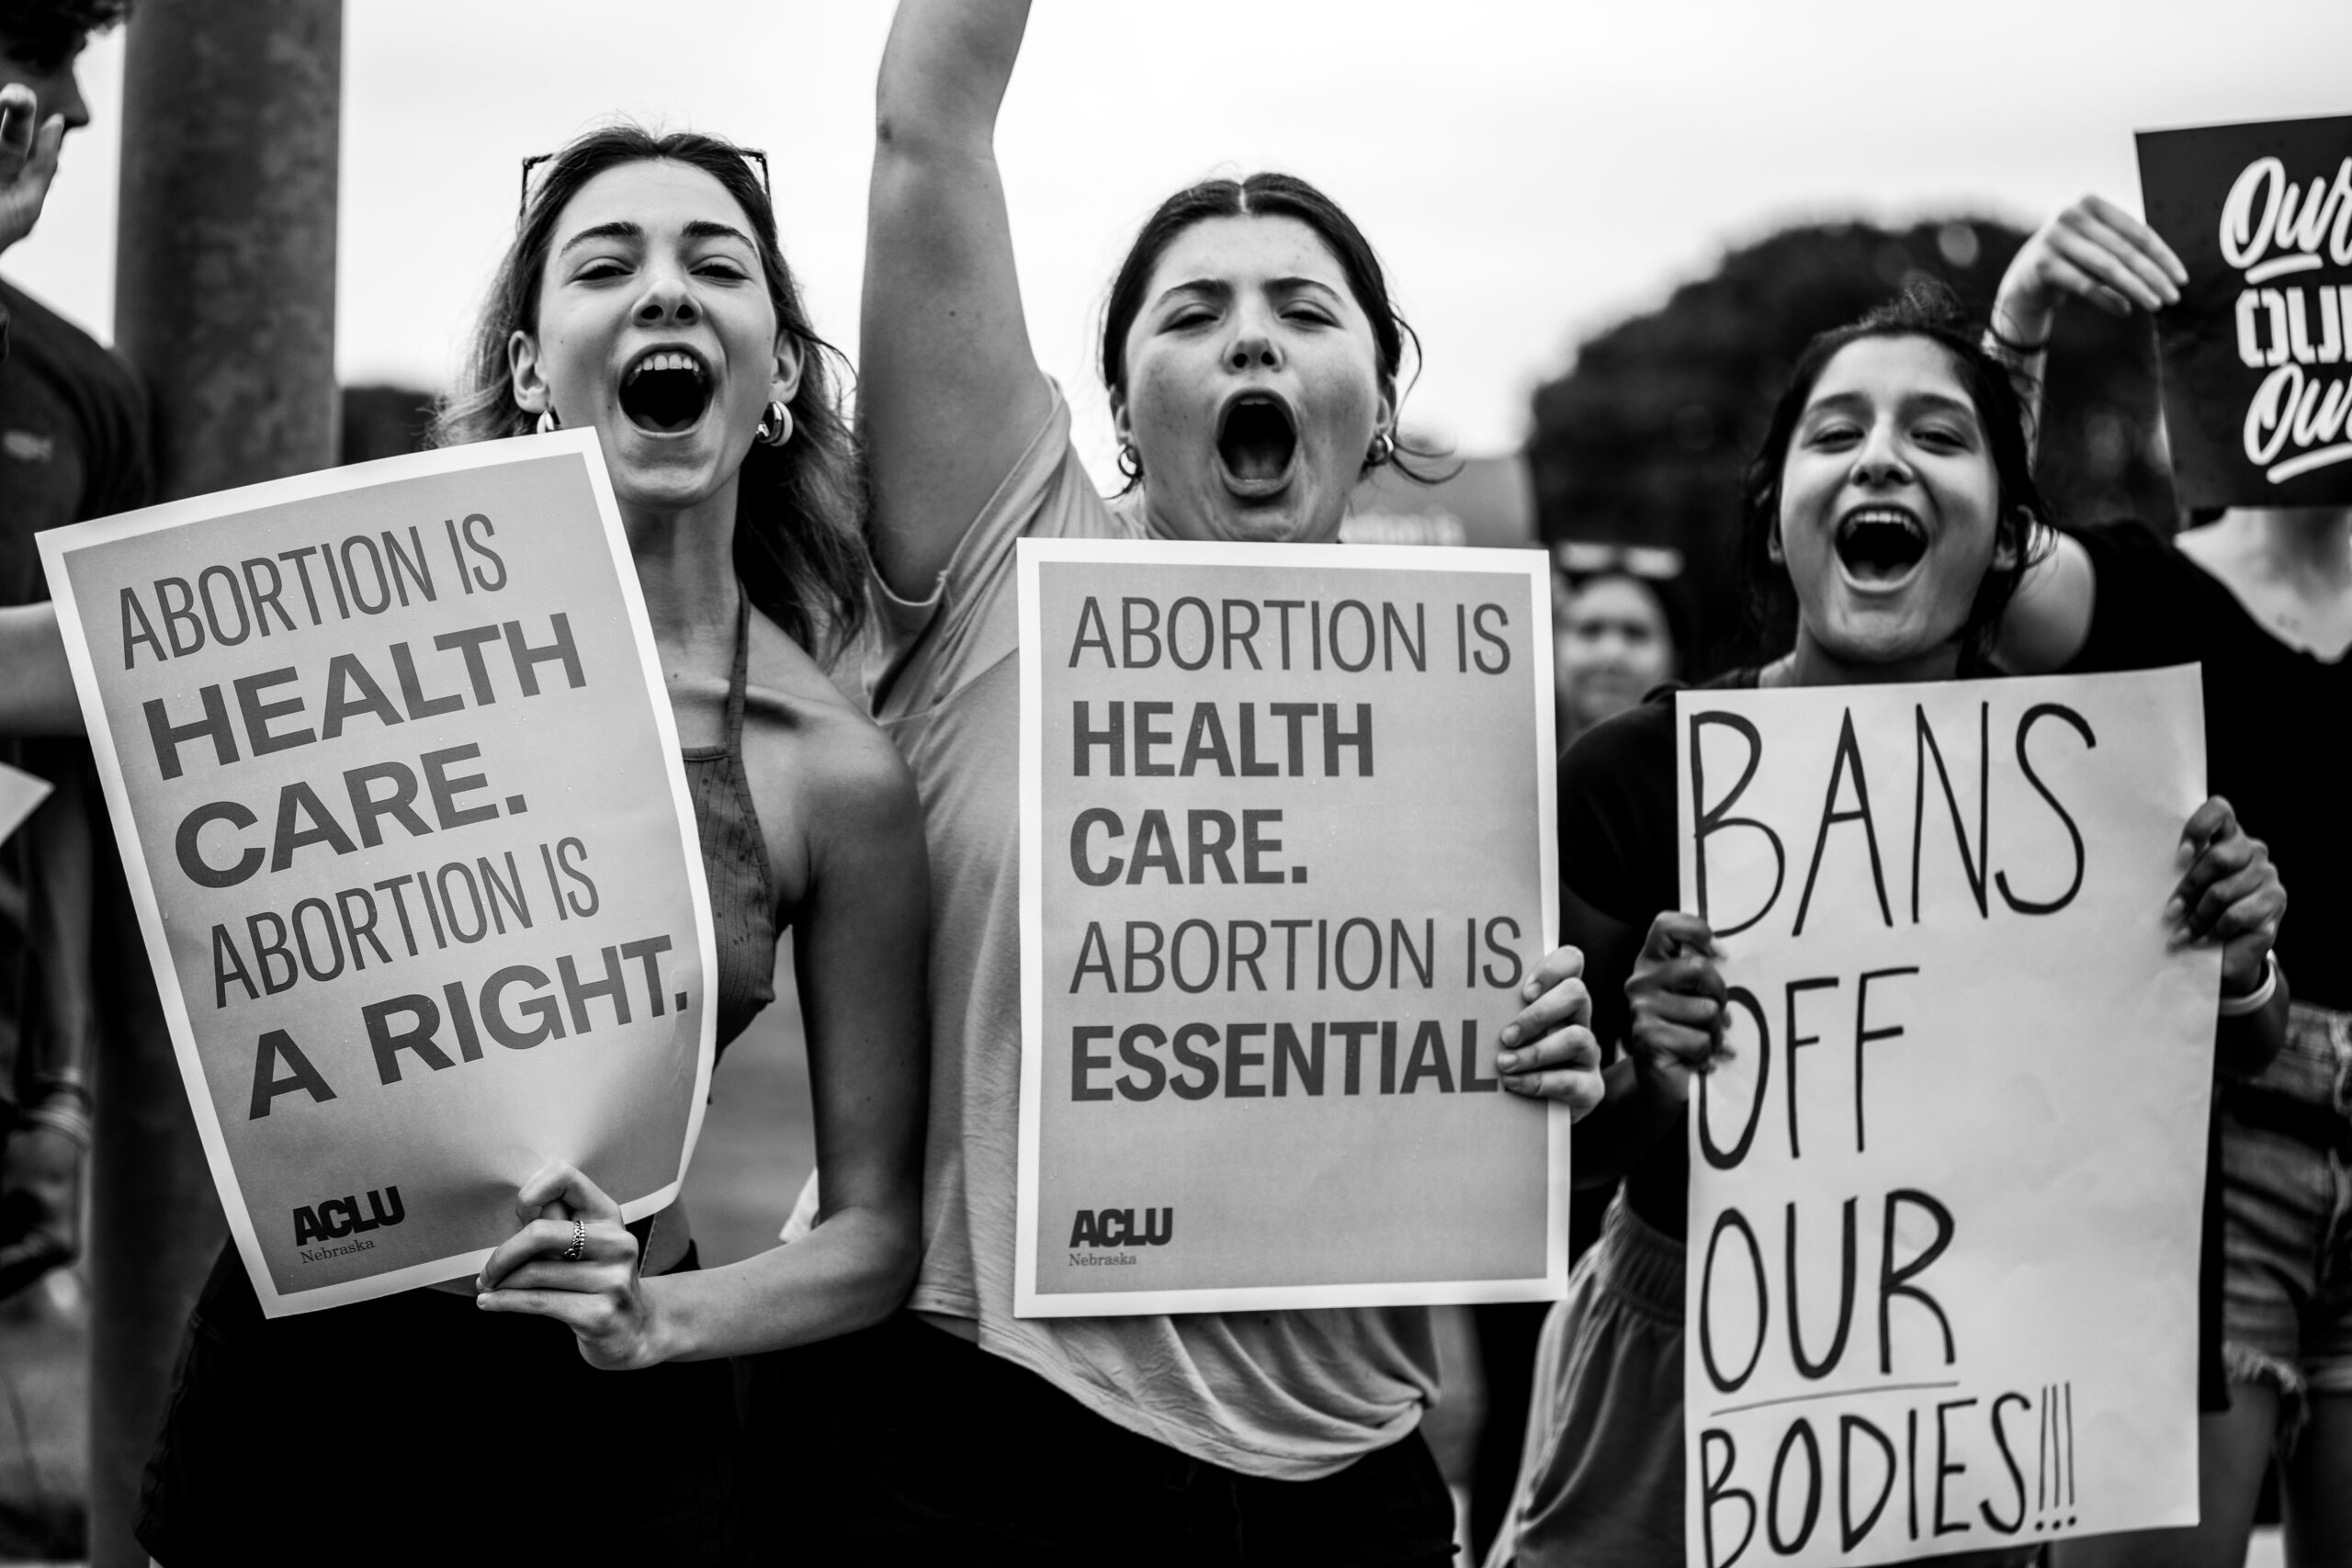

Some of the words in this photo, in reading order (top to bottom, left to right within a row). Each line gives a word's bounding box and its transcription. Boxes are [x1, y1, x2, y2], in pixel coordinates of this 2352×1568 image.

[2235, 286, 2352, 367] OU
[2243, 362, 2352, 466] Ou
[119, 525, 438, 671] ABORTION
[444, 513, 508, 595] IS
[1068, 595, 1427, 672] ABORTION
[1455, 603, 1511, 675] IS
[142, 612, 587, 781] HEALTH
[1072, 700, 1374, 777] HEALTH
[175, 742, 528, 888] CARE.
[1069, 807, 1308, 887] CARE.
[1690, 700, 2097, 939] BANS
[211, 851, 533, 1010] ABORTION
[538, 836, 600, 921] IS
[1068, 917, 1435, 994] ABORTION
[1466, 916, 1523, 989] IS
[248, 1028, 338, 1121] A
[361, 934, 689, 1087] RIGHT.
[1070, 1019, 1507, 1102] ESSENTIAL
[1697, 966, 1920, 1170] OFF
[292, 1185, 406, 1247] ACLU
[300, 1239, 376, 1265] Nebraska
[1069, 1207, 1173, 1248] ACLU
[1069, 1251, 1137, 1267] Nebraska
[1700, 1188, 1956, 1393] OUR
[1701, 1382, 2076, 1568] BODIES!!!
